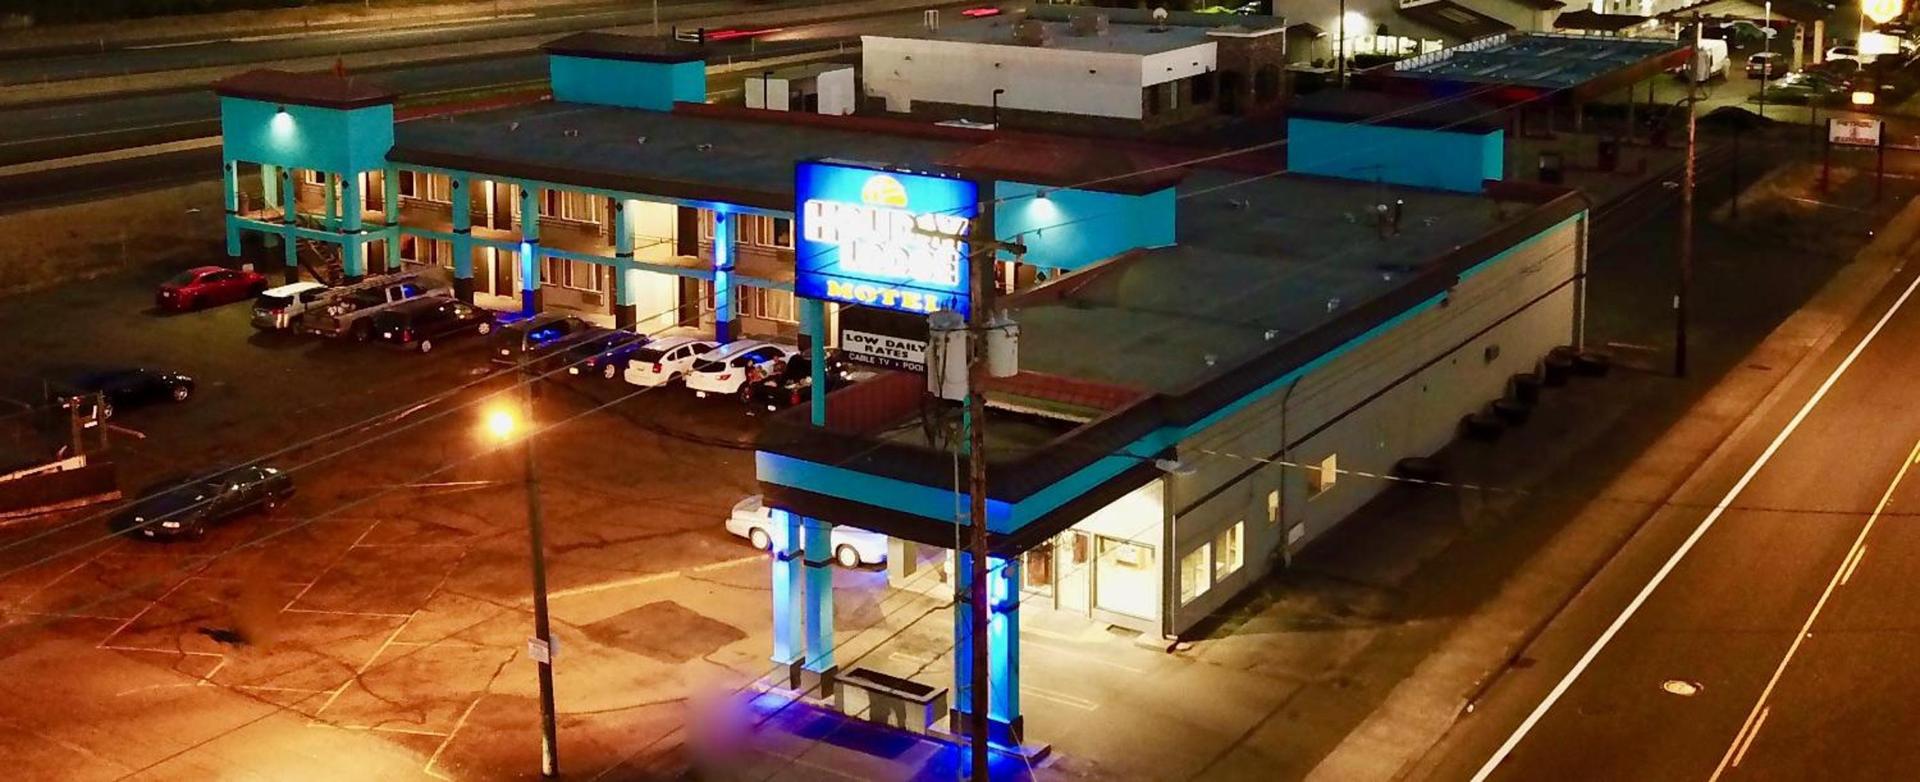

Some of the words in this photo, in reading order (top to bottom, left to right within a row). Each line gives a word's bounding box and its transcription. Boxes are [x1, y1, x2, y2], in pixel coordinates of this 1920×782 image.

[826, 279, 941, 313] MOTEL
[845, 333, 879, 345] LOW
[885, 339, 927, 353] DAILY
[864, 344, 909, 359] RATES
[848, 352, 875, 364] CABLE
[879, 357, 890, 366] TV
